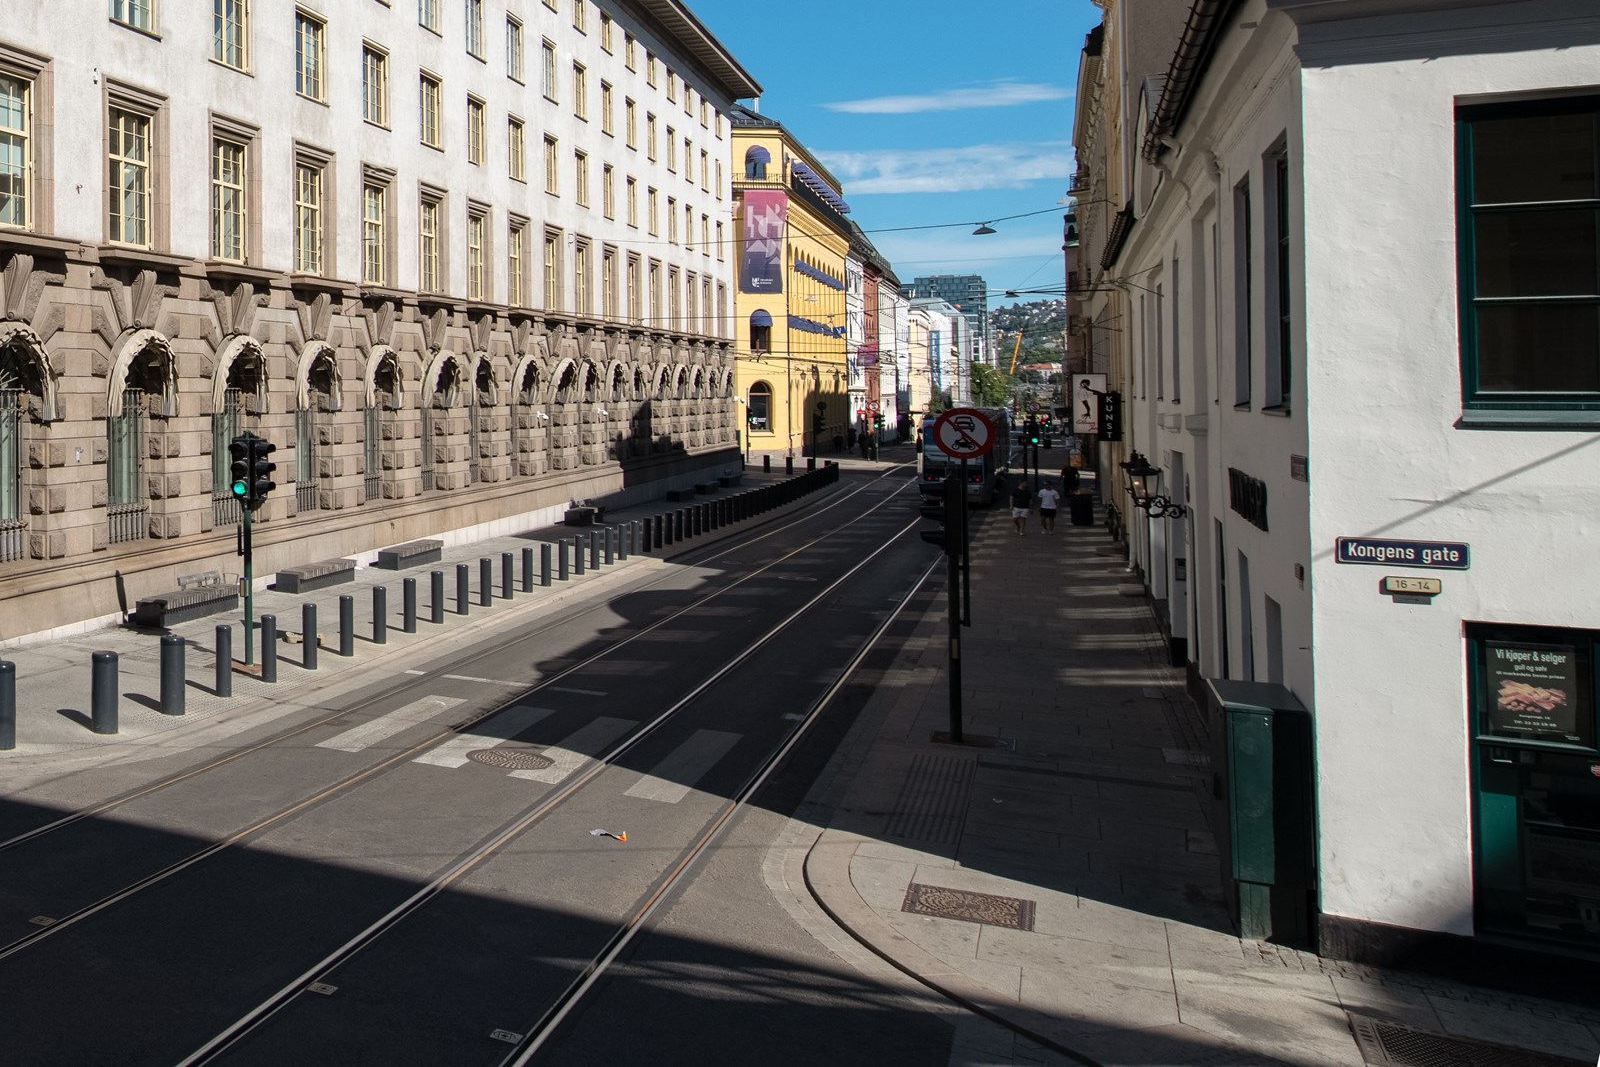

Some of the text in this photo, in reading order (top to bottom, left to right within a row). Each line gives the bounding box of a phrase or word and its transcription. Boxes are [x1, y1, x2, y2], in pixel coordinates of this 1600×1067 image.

[1105, 396, 1113, 439] KUNST
[1347, 542, 1459, 563] Kongens gate
[1395, 580, 1407, 589] 16
[1496, 649, 1566, 665] Vi kjøper & selger
